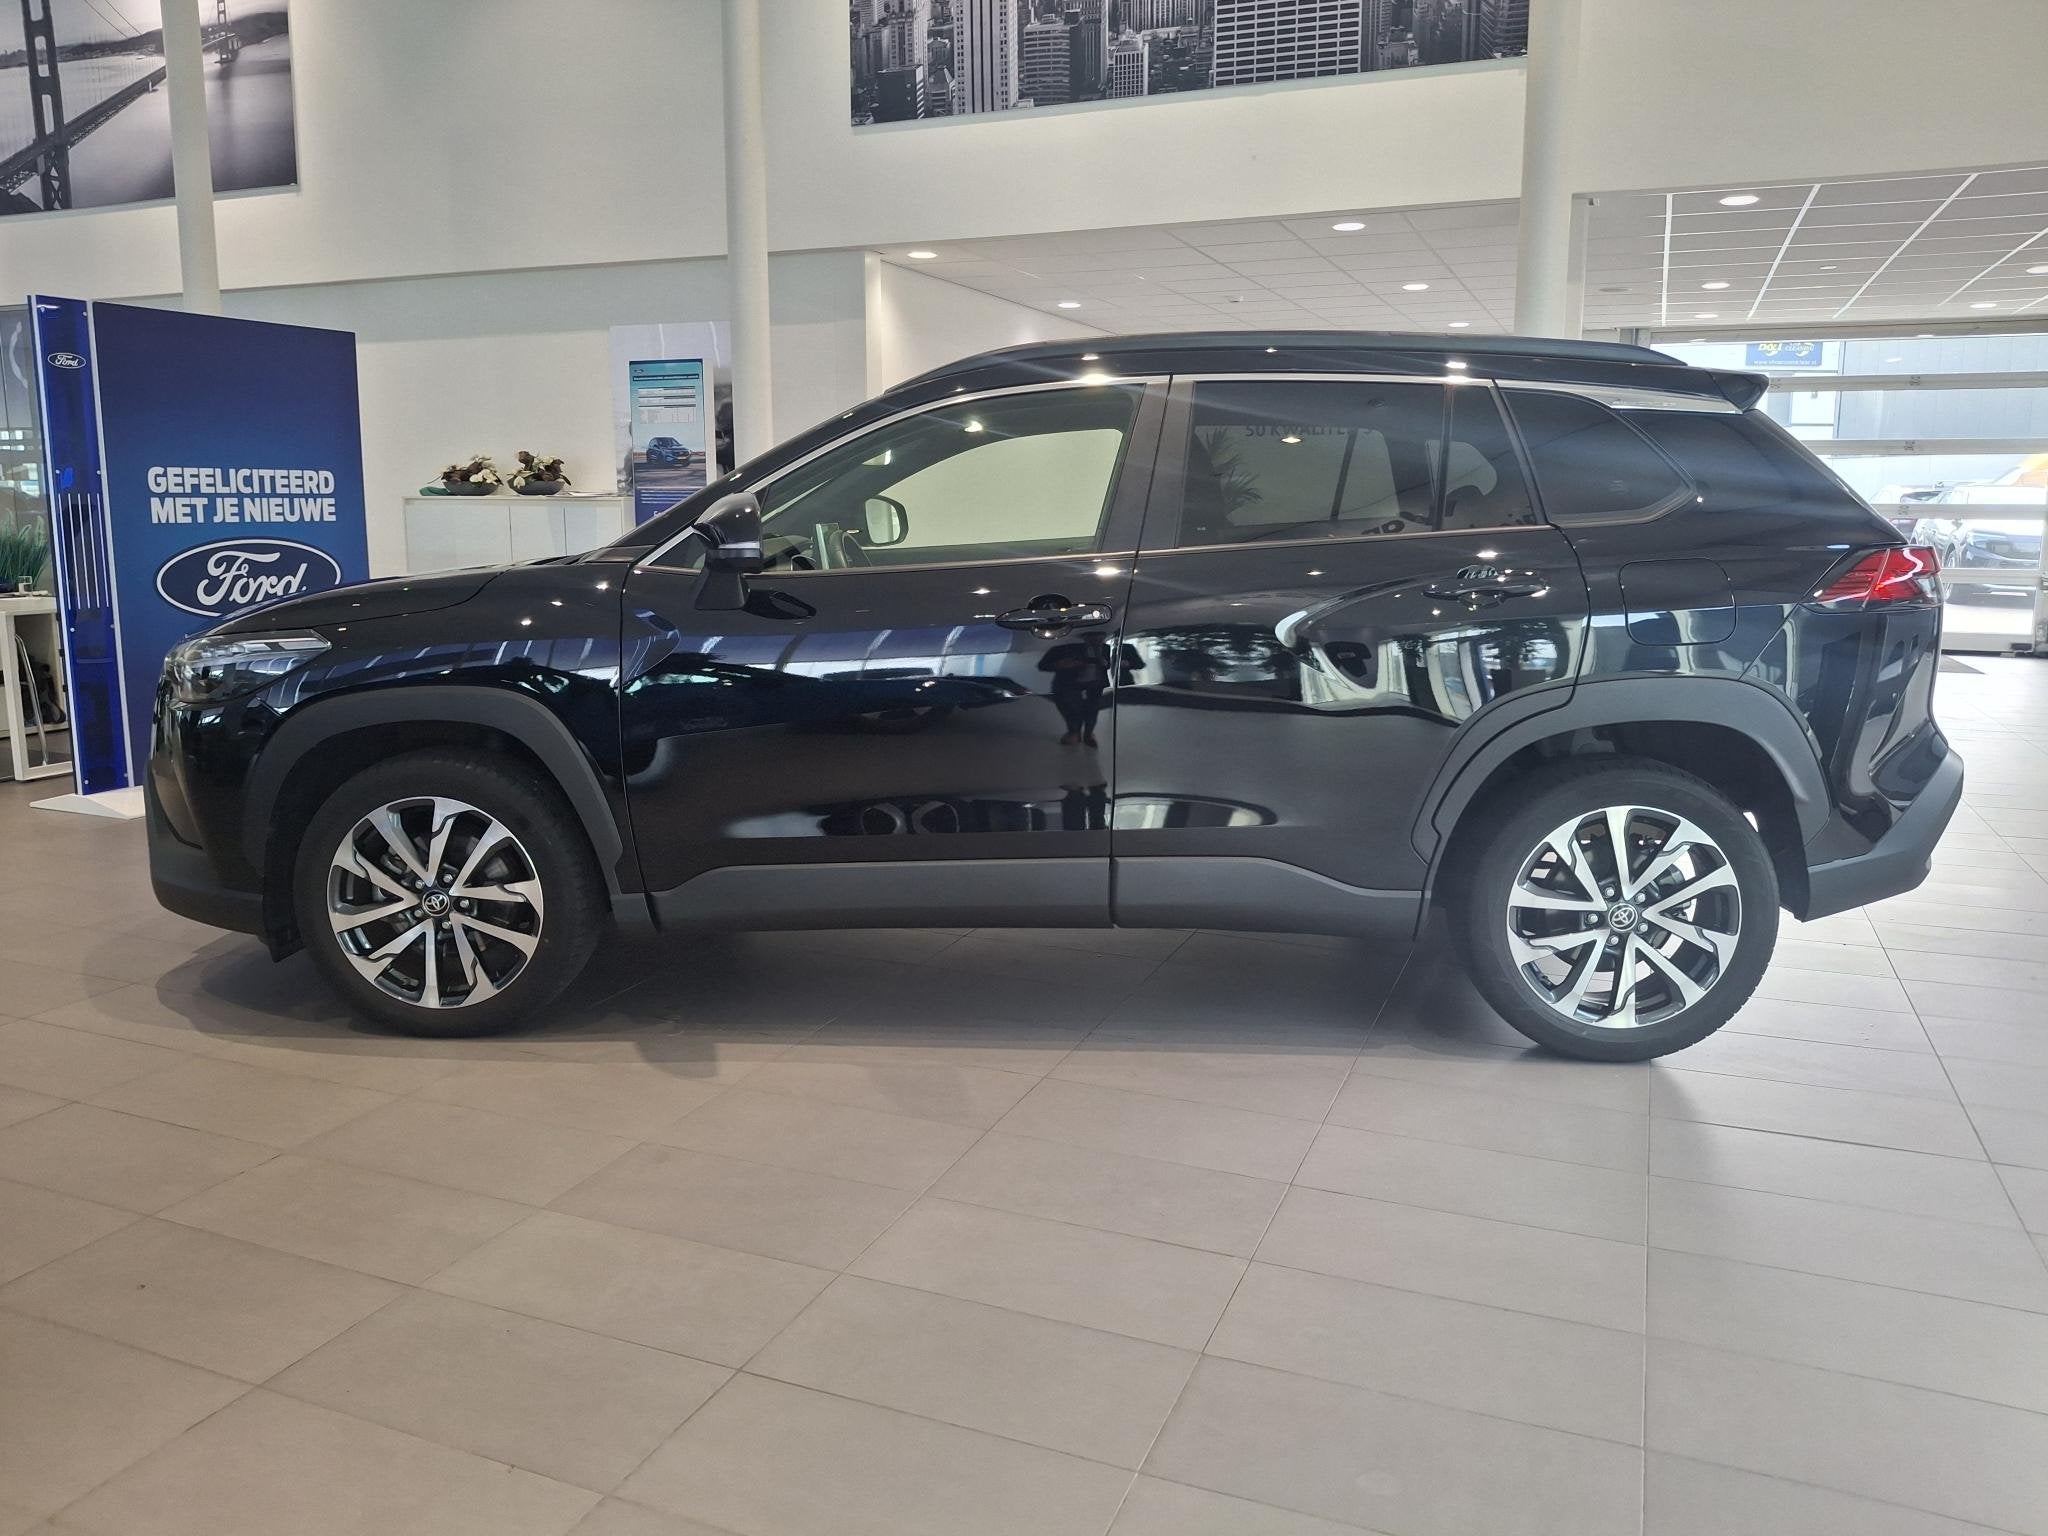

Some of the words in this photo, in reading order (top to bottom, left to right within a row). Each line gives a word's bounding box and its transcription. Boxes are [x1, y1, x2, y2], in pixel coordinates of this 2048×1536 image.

[147, 466, 336, 495] GEFELICITEERD
[151, 497, 209, 524] MET
[213, 497, 240, 523] JE
[243, 497, 337, 523] NIEUWE
[196, 550, 308, 606] Ford
